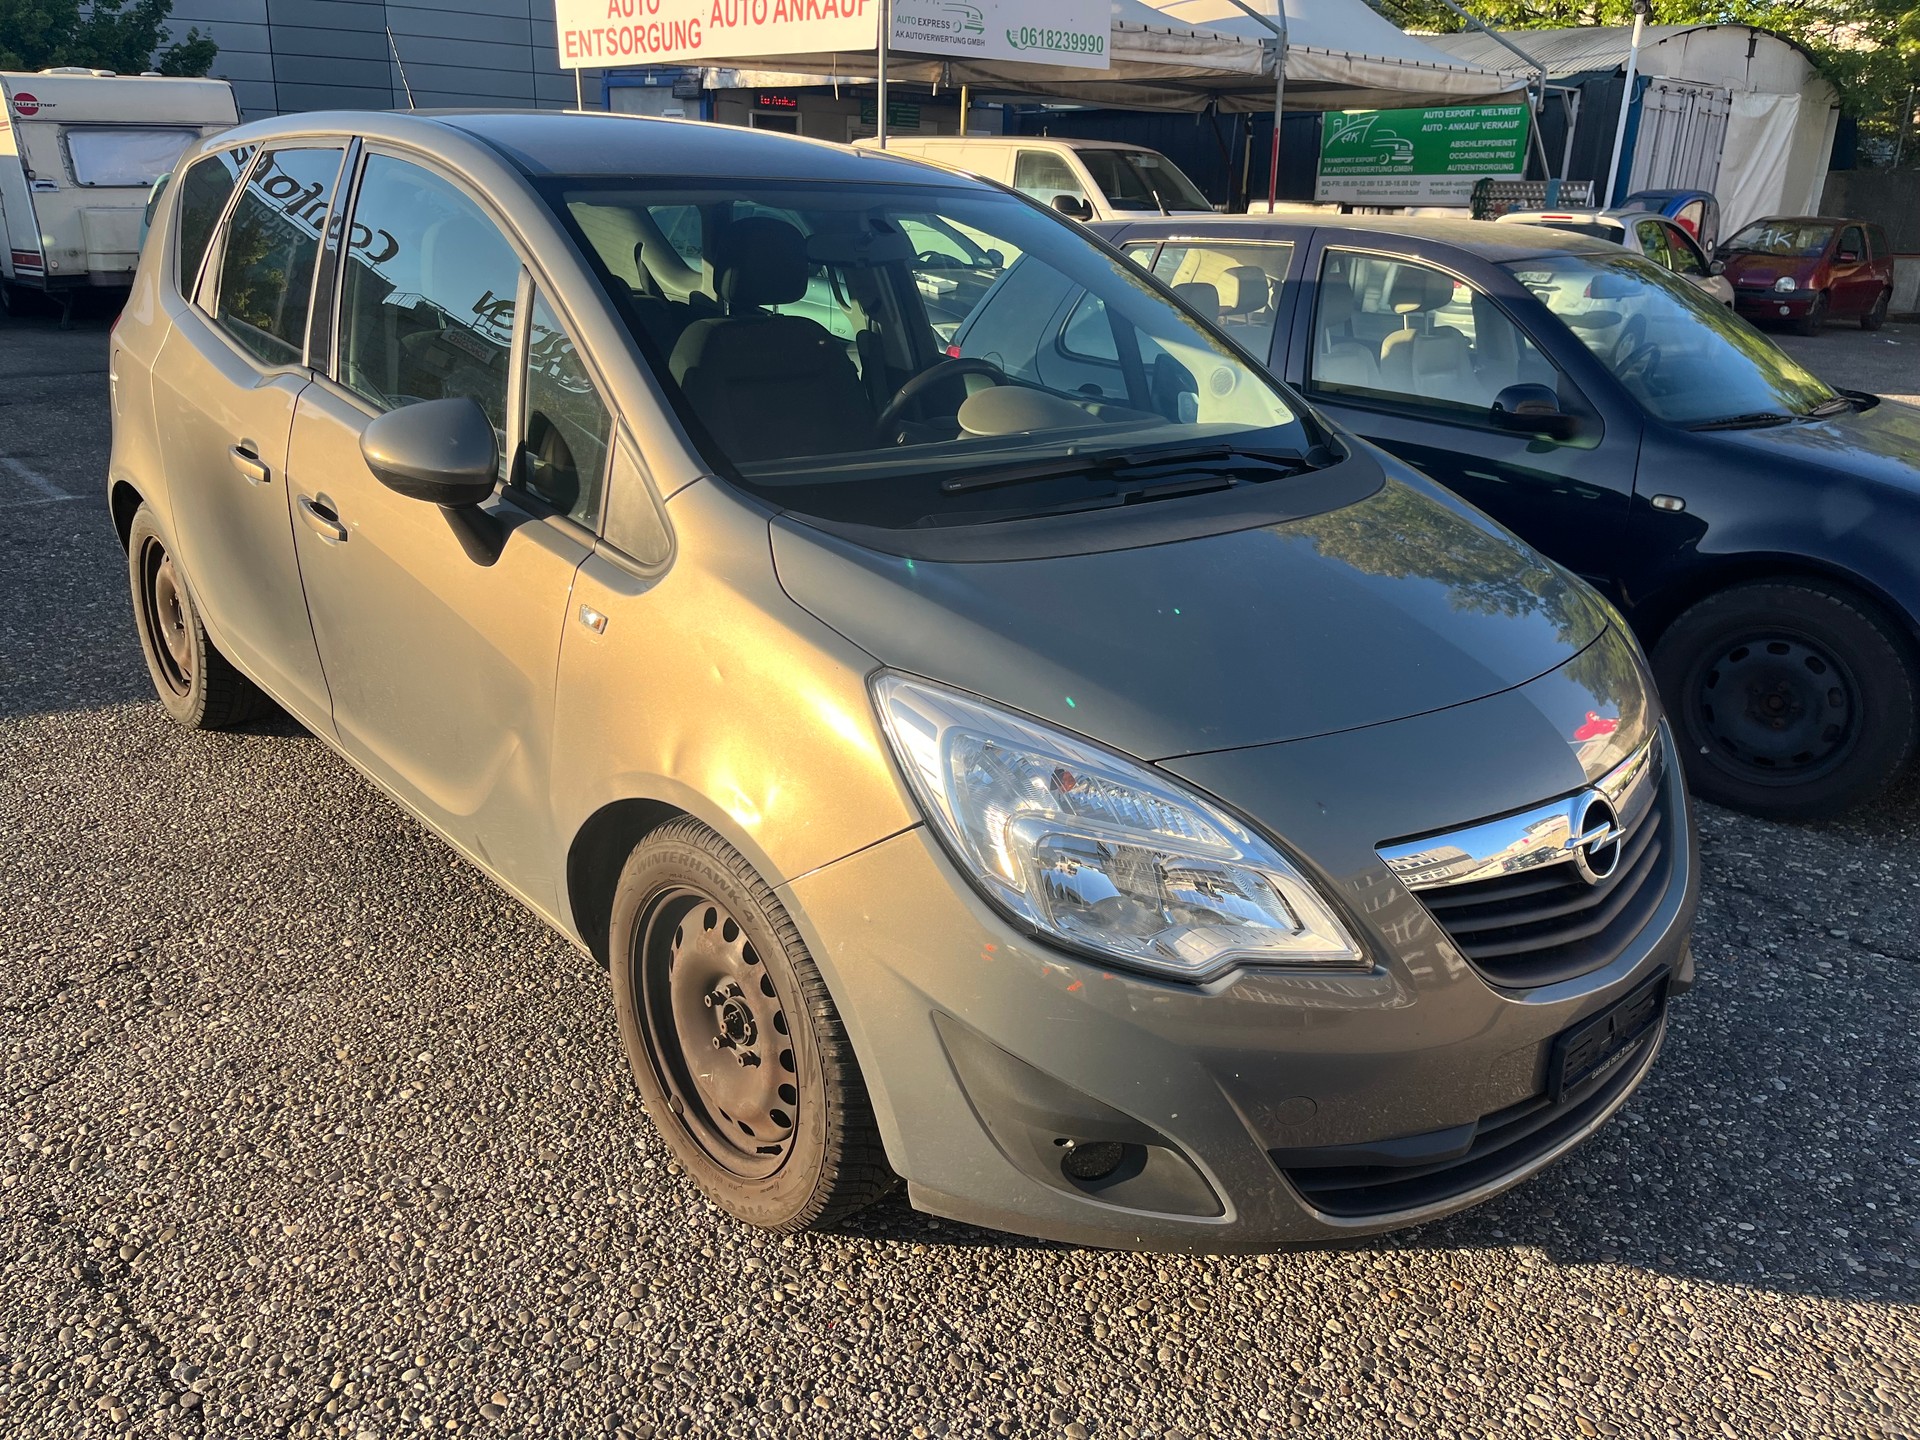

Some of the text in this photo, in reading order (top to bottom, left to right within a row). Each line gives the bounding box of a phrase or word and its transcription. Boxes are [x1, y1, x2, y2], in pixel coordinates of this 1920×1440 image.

[607, 0, 660, 19] AUTO
[709, 0, 768, 28] AUTO
[896, 15, 951, 29] AUTO EXPRESS
[565, 18, 702, 58] ENTSORGUNG
[895, 30, 986, 47] AK AUTOVERWERTUNG GMBH
[1020, 26, 1104, 53] 0618239990
[1423, 110, 1444, 119] AUTO
[1445, 109, 1476, 118] EXPORT
[1481, 107, 1522, 116] WELTWEIT
[1421, 123, 1443, 132] AUTO
[1448, 122, 1481, 131] ANKAUF
[1481, 121, 1520, 130] VERKAUF
[1450, 139, 1517, 148] ABSCHLEPPDIENST
[1449, 151, 1516, 160] OCCASIONEN PNEU
[1331, 165, 1392, 173] AUTOVERWERTUNG
[1447, 163, 1514, 171] AUTOENTSORGUNG
[636, 851, 742, 906] WINTERHAWK
